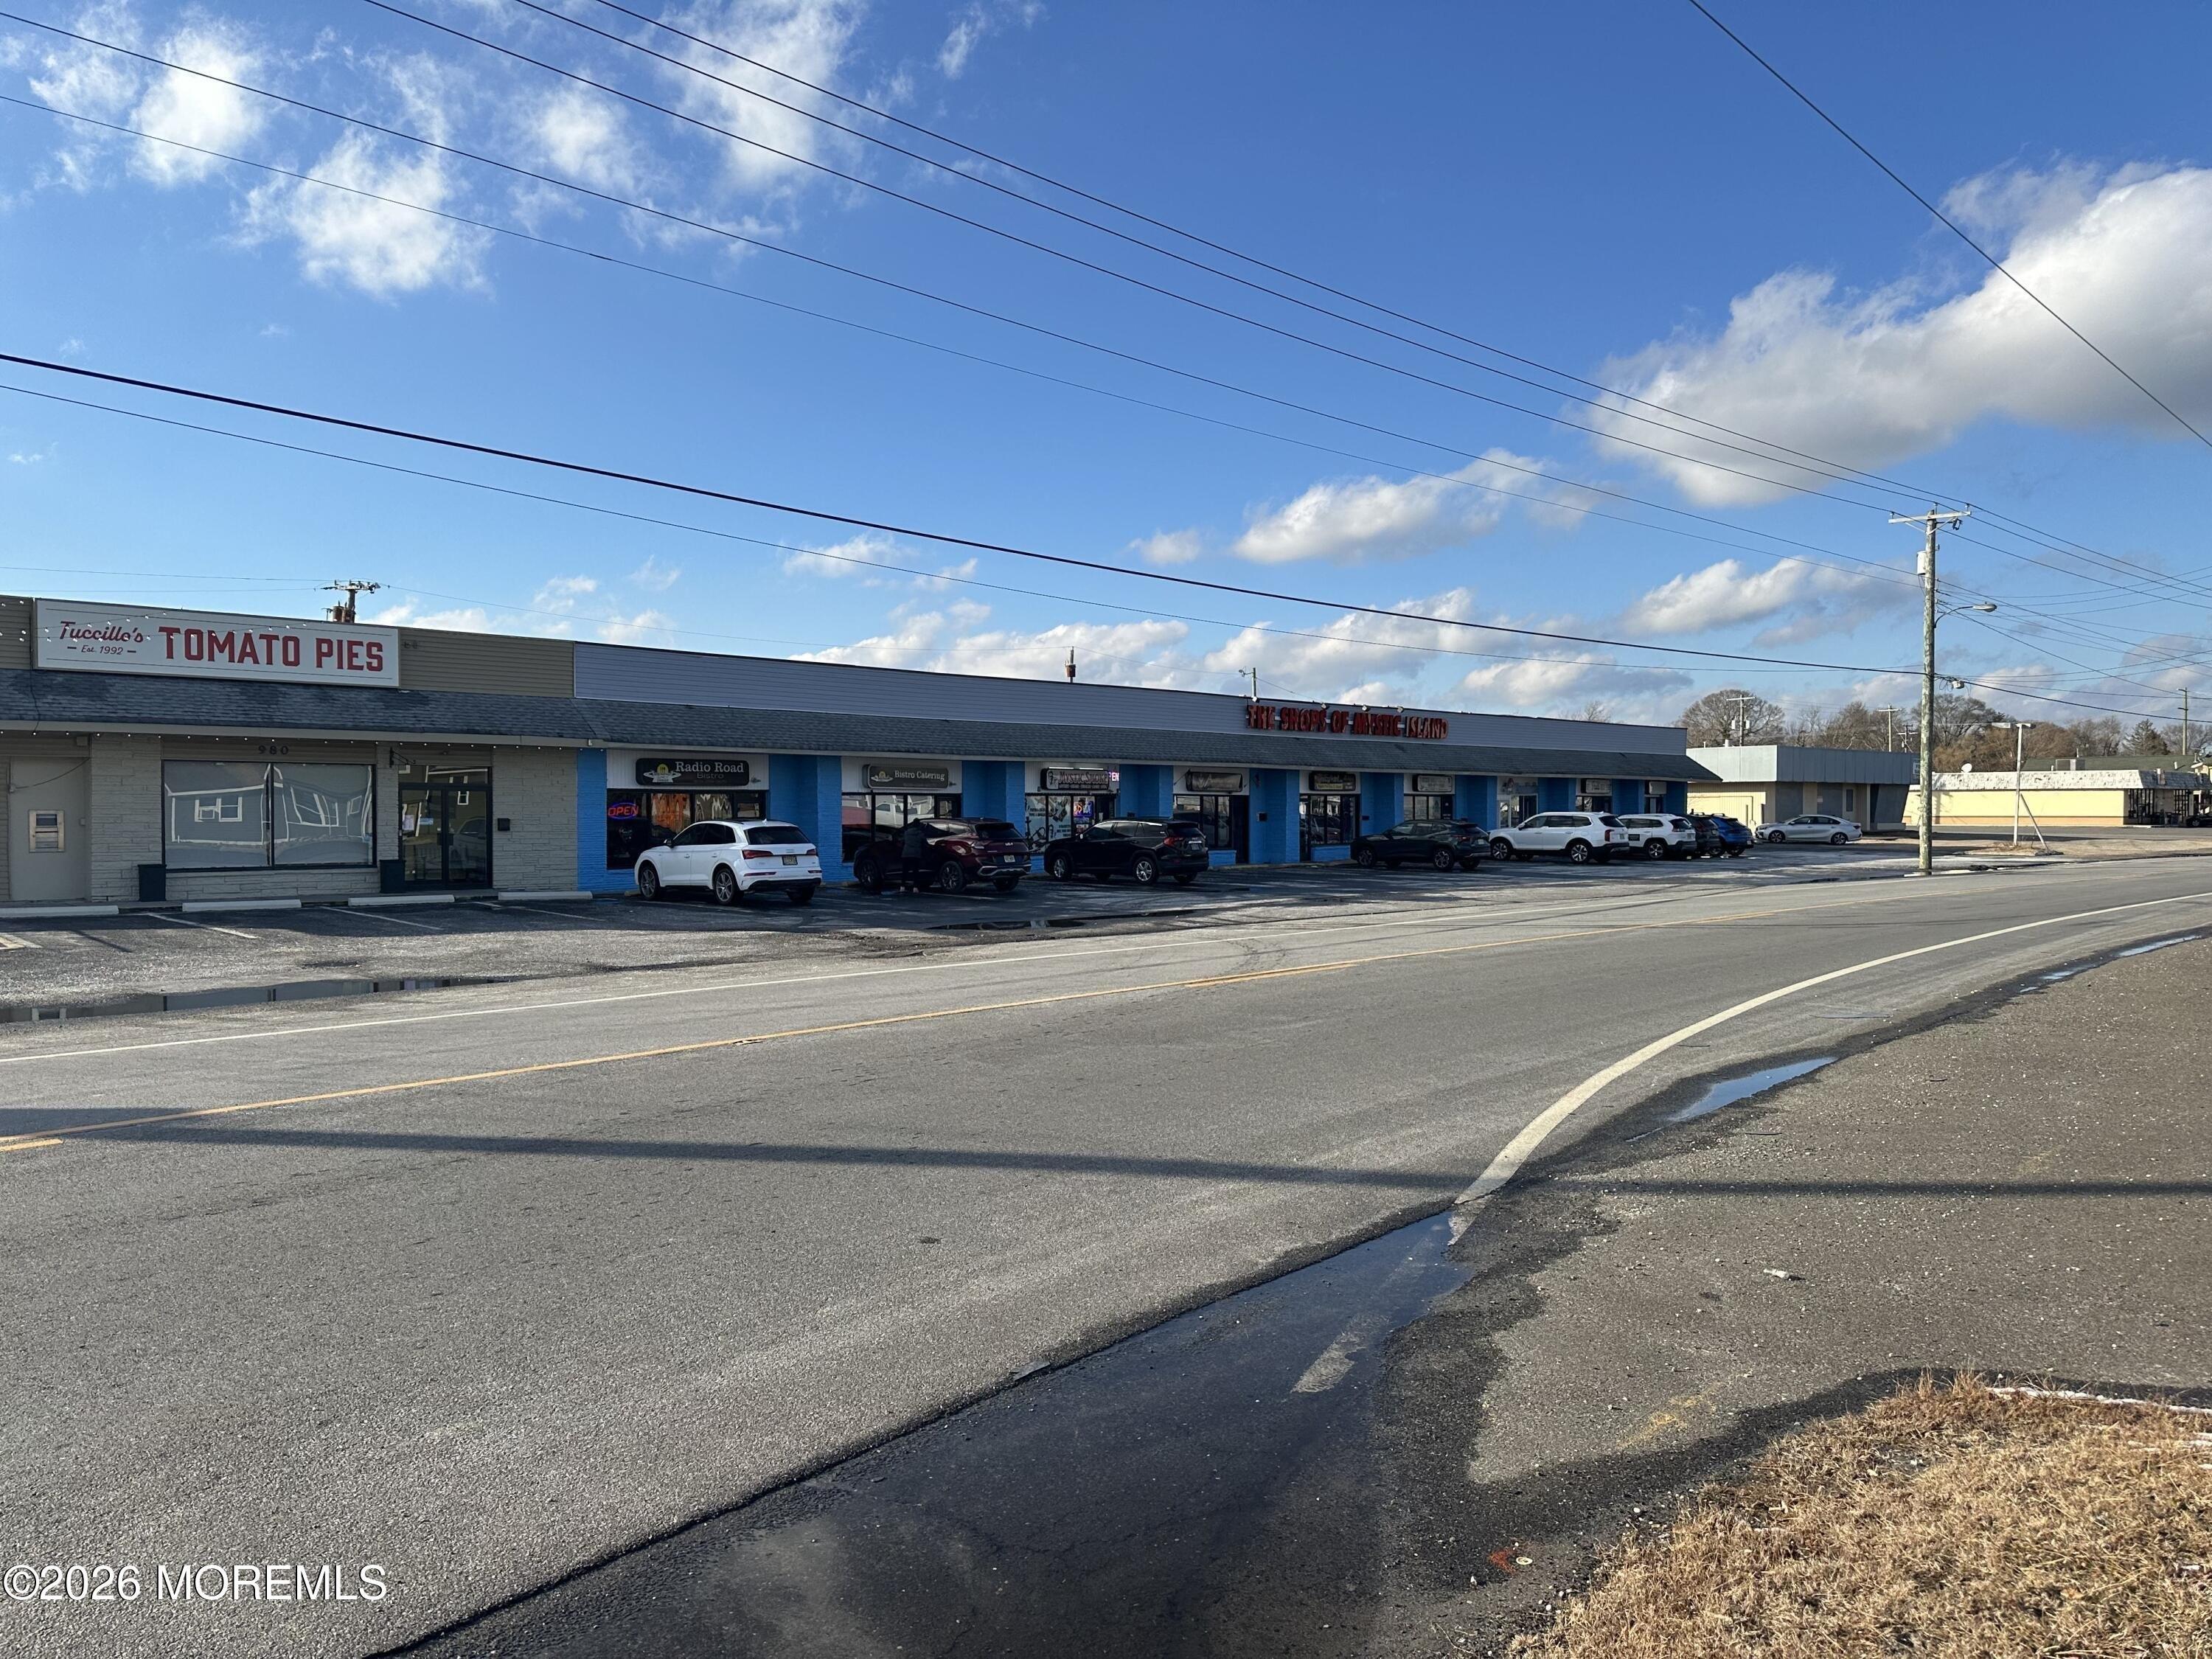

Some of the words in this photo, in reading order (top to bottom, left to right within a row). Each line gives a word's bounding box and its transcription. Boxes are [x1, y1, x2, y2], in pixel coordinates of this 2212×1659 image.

[59, 620, 144, 643] Tuccillo's
[100, 646, 124, 655] 1992
[158, 626, 301, 667] TOMATO
[315, 637, 383, 672] PIES
[1247, 705, 1275, 730] THE
[1279, 706, 1326, 732] SHOPS
[1331, 709, 1349, 734] OF
[1352, 712, 1401, 737] MYSTIC
[1404, 716, 1449, 740] ISLAND
[258, 745, 289, 755] 980
[675, 761, 711, 772] Radio
[714, 762, 744, 773] Road
[894, 770, 915, 779] Bistro
[608, 806, 639, 816] OPEN
